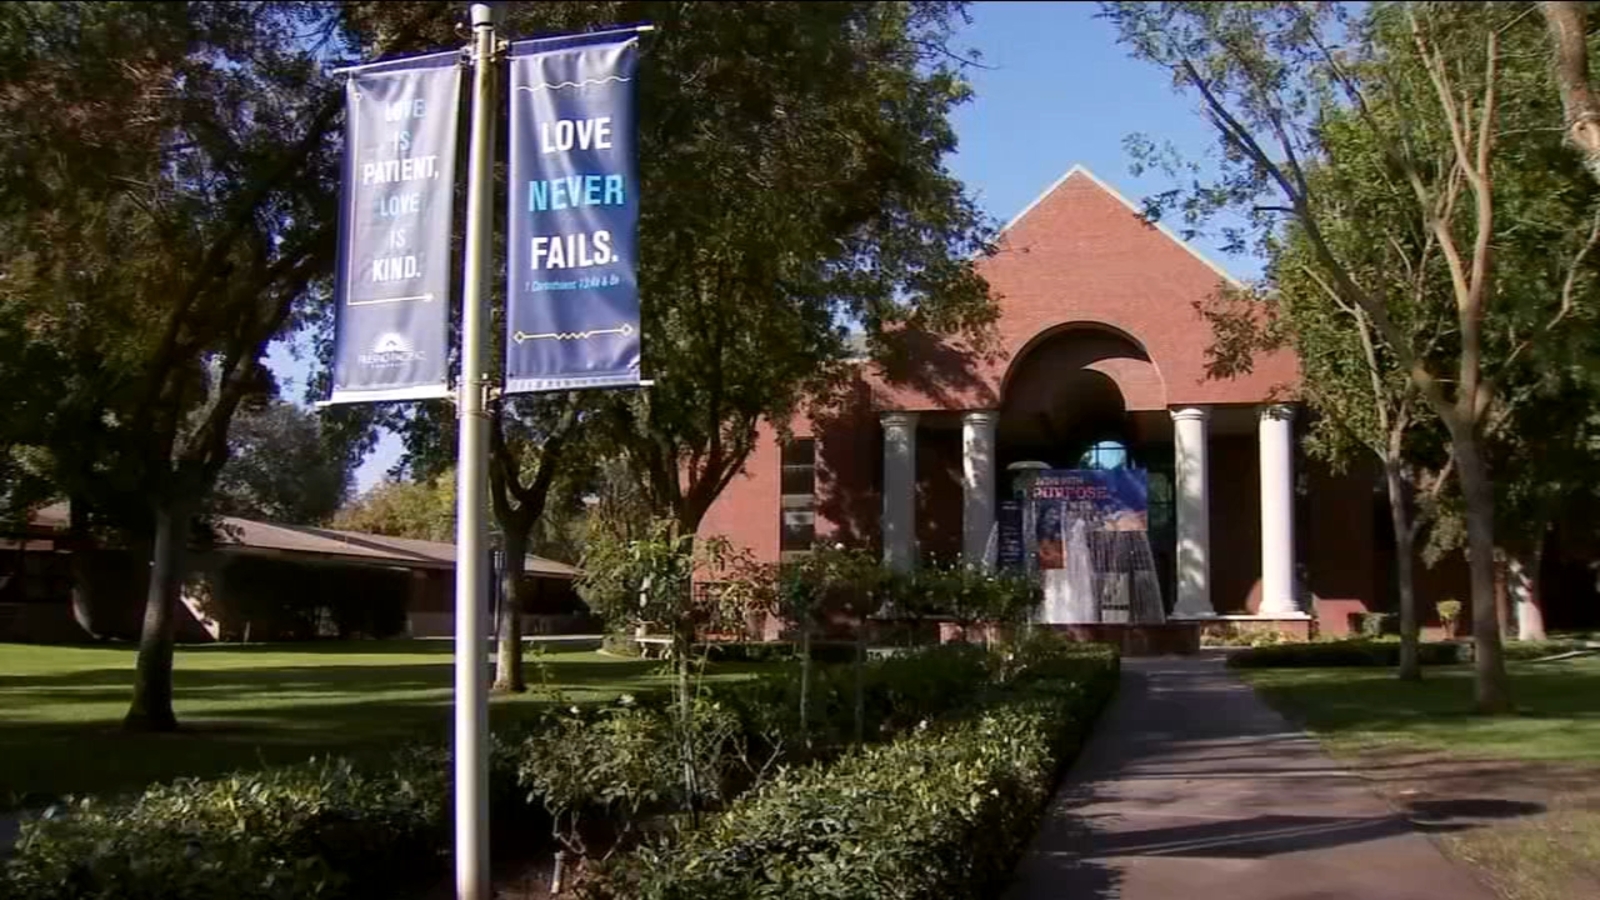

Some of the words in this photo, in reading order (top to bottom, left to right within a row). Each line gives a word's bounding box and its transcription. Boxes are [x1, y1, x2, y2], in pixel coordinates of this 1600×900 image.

[386, 100, 426, 121] LOVE
[394, 130, 411, 151] IS
[541, 116, 612, 154] LOVE
[363, 156, 439, 186] PATIENT,
[380, 193, 419, 217] LOVE
[528, 174, 624, 212] NEVER
[390, 229, 406, 248] IS
[531, 230, 618, 269] FAILS.
[373, 255, 421, 282] KIND.
